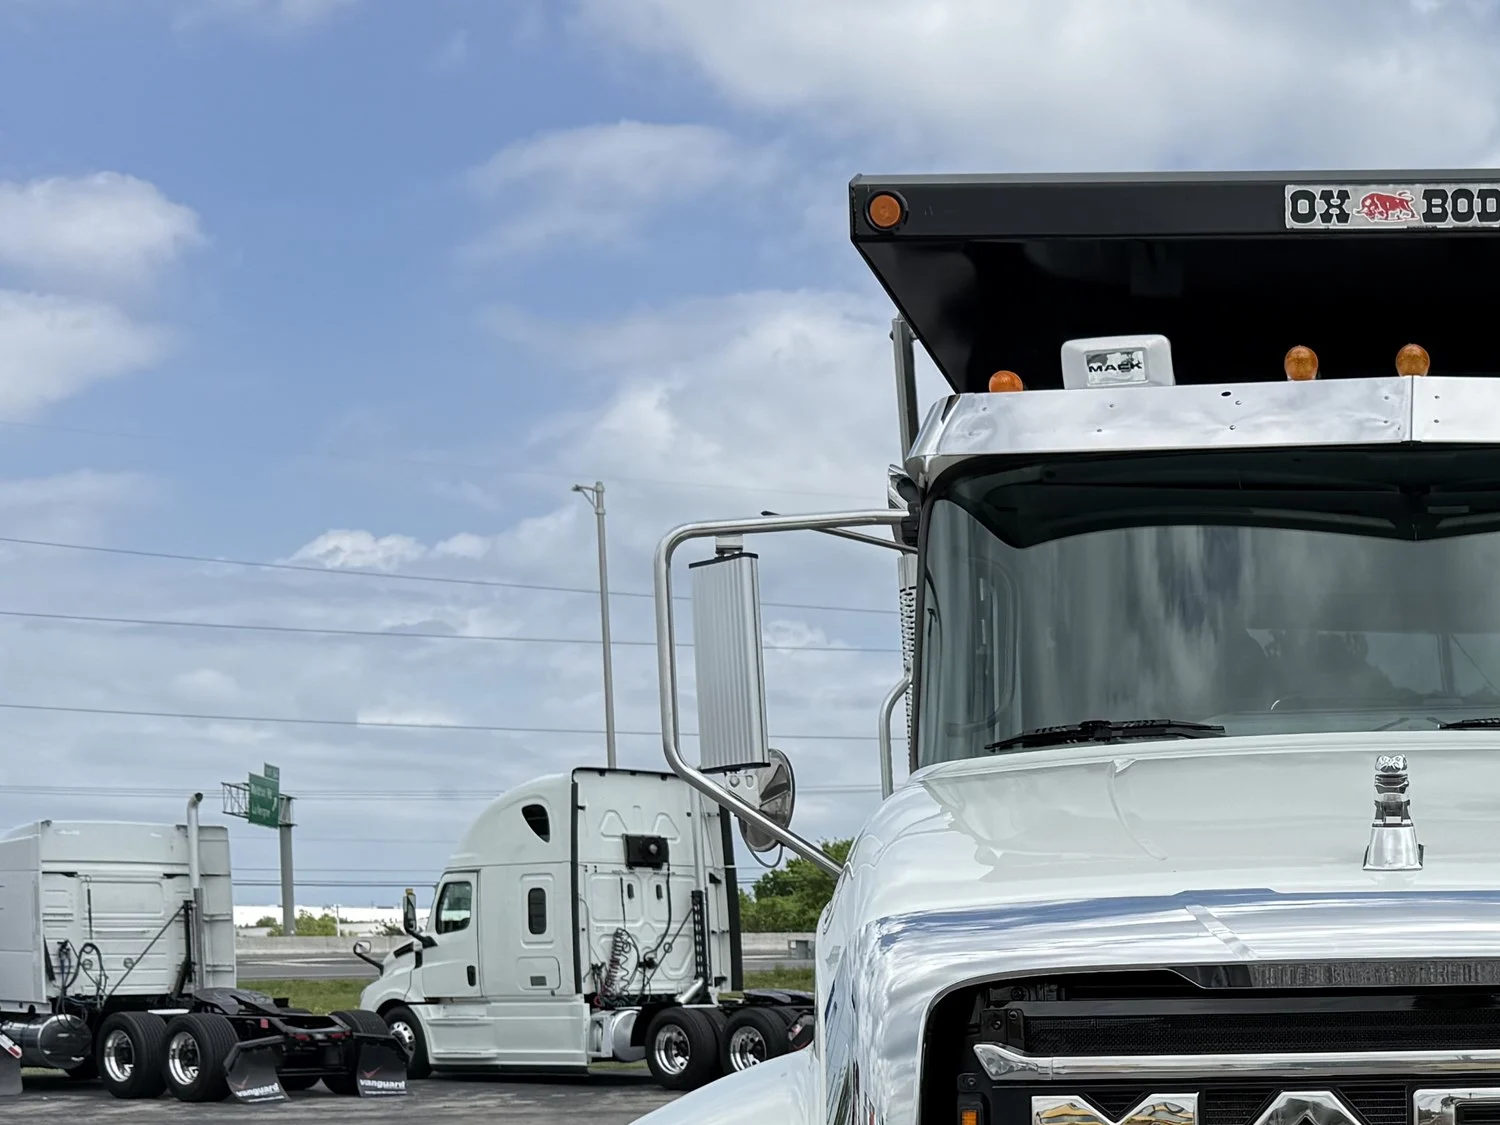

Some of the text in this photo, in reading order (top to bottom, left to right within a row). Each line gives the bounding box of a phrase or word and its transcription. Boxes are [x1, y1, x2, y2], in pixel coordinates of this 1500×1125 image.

[1290, 188, 1351, 224] OX
[1088, 360, 1142, 373] MACK
[235, 1082, 280, 1097] vanguard
[359, 1079, 406, 1089] vanguard
